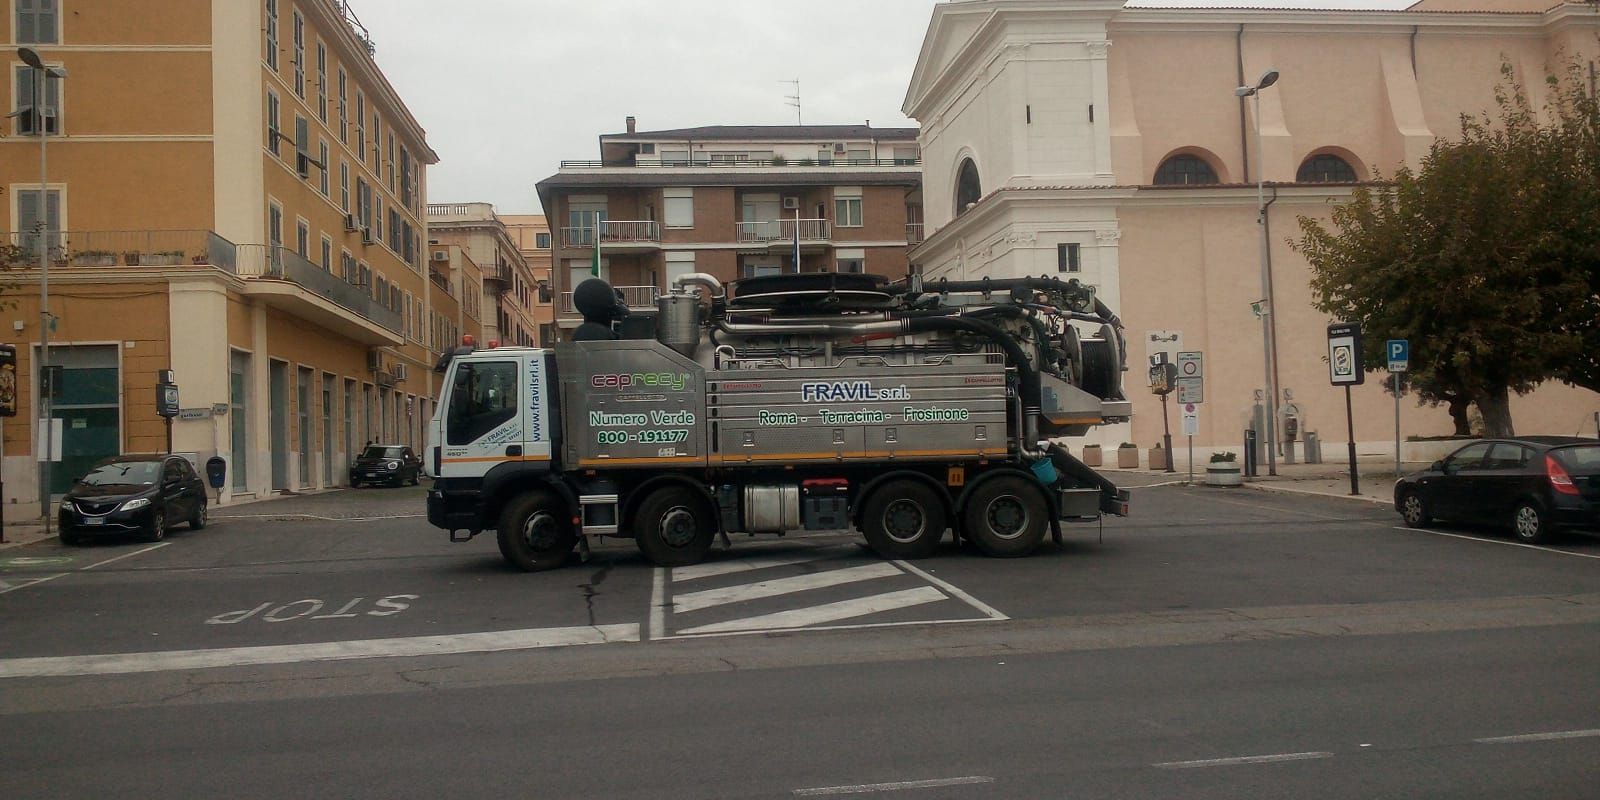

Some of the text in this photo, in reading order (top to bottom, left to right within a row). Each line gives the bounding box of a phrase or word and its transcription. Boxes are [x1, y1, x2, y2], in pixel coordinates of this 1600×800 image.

[1392, 343, 1403, 359] P
[592, 372, 685, 392] caprecy
[802, 381, 911, 401] FRAVIL s.r.l.
[529, 359, 541, 442] www.fravilsrl.it
[590, 409, 696, 427] Numero Verde
[759, 410, 798, 425] Roma
[819, 407, 883, 424] Terracina
[903, 406, 968, 422] Frosinone
[598, 430, 628, 444] 800
[638, 429, 689, 444] 191177
[204, 594, 421, 625] STOP
